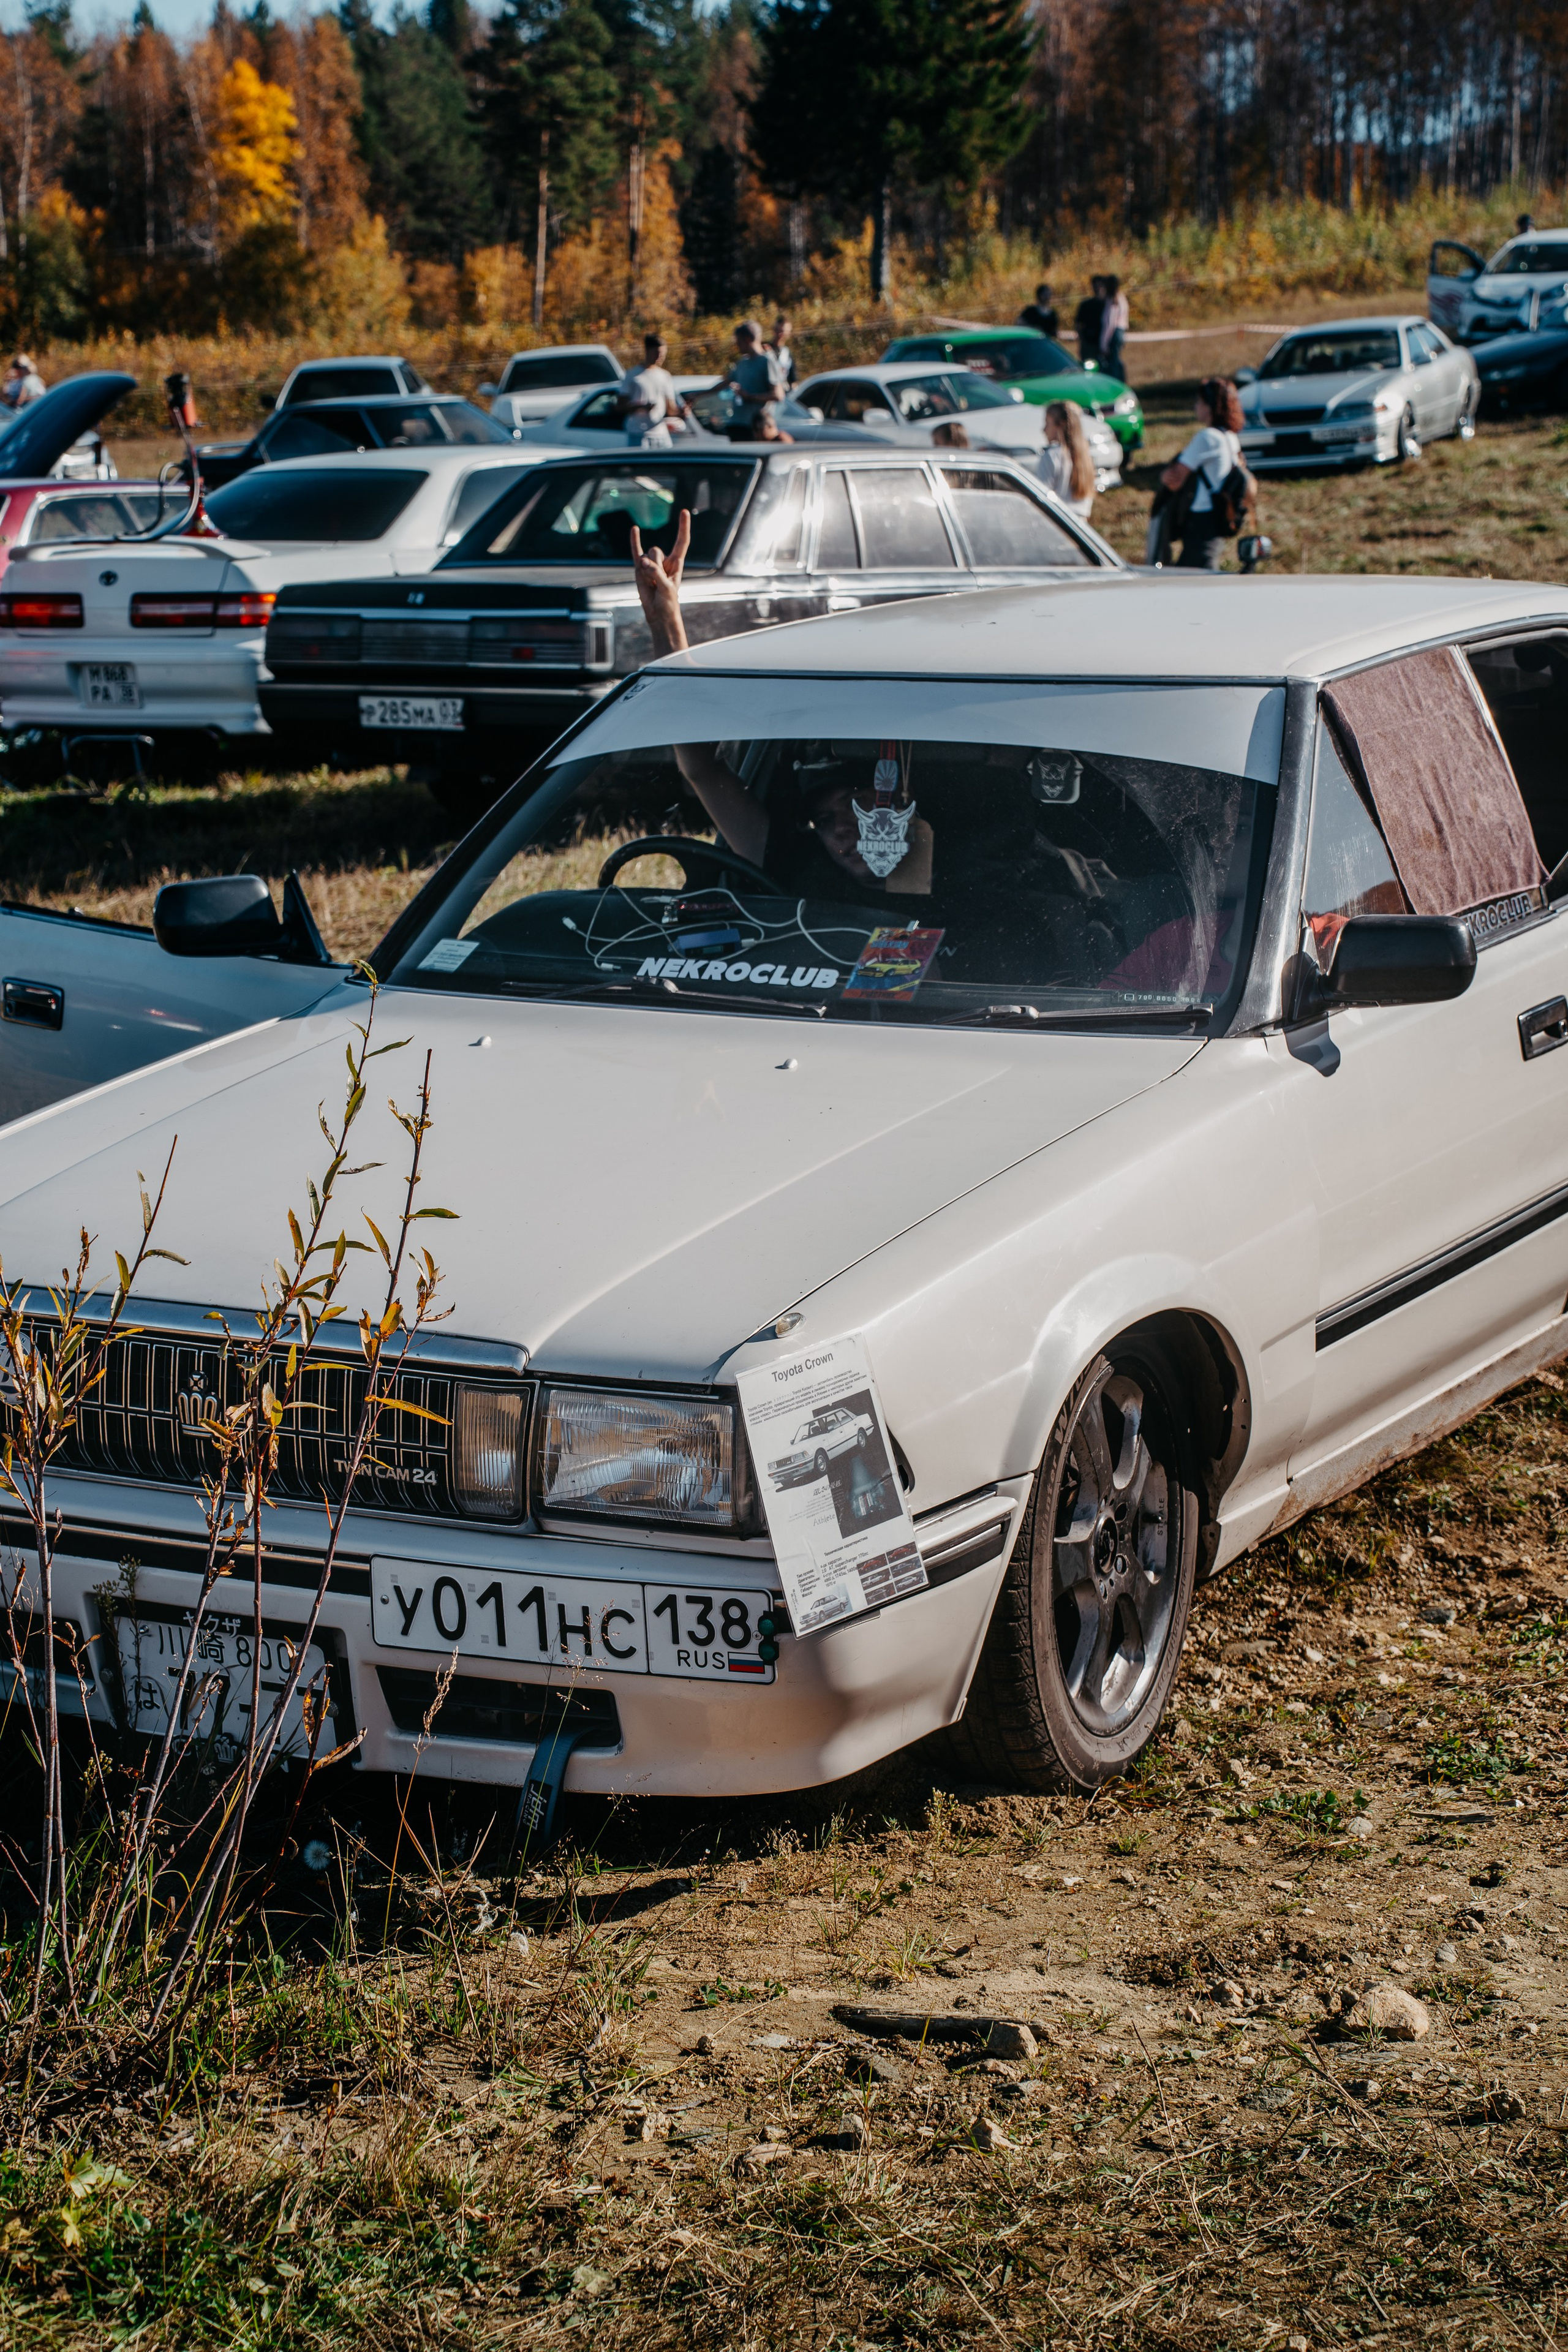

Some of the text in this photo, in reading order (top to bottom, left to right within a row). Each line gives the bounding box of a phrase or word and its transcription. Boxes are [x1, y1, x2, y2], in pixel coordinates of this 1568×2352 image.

[1459, 892, 1533, 938] KROCLUB
[636, 957, 840, 989] NEKROCLUB
[772, 1353, 834, 1382] Toyota Crown
[374, 1465, 410, 1482] CAM
[412, 1468, 437, 1485] 24
[813, 1514, 835, 1526] Athlete
[824, 1536, 868, 1556] Техническая характеристика
[827, 1557, 842, 1566] хардтоп
[835, 1556, 858, 1567] supercharger
[798, 1574, 815, 1584] Двигатель:
[799, 1577, 821, 1588] Трансмиссия:
[393, 1576, 752, 1659] У011НС 138
[677, 1649, 725, 1670] RUS
[523, 1793, 532, 1824] RACING
